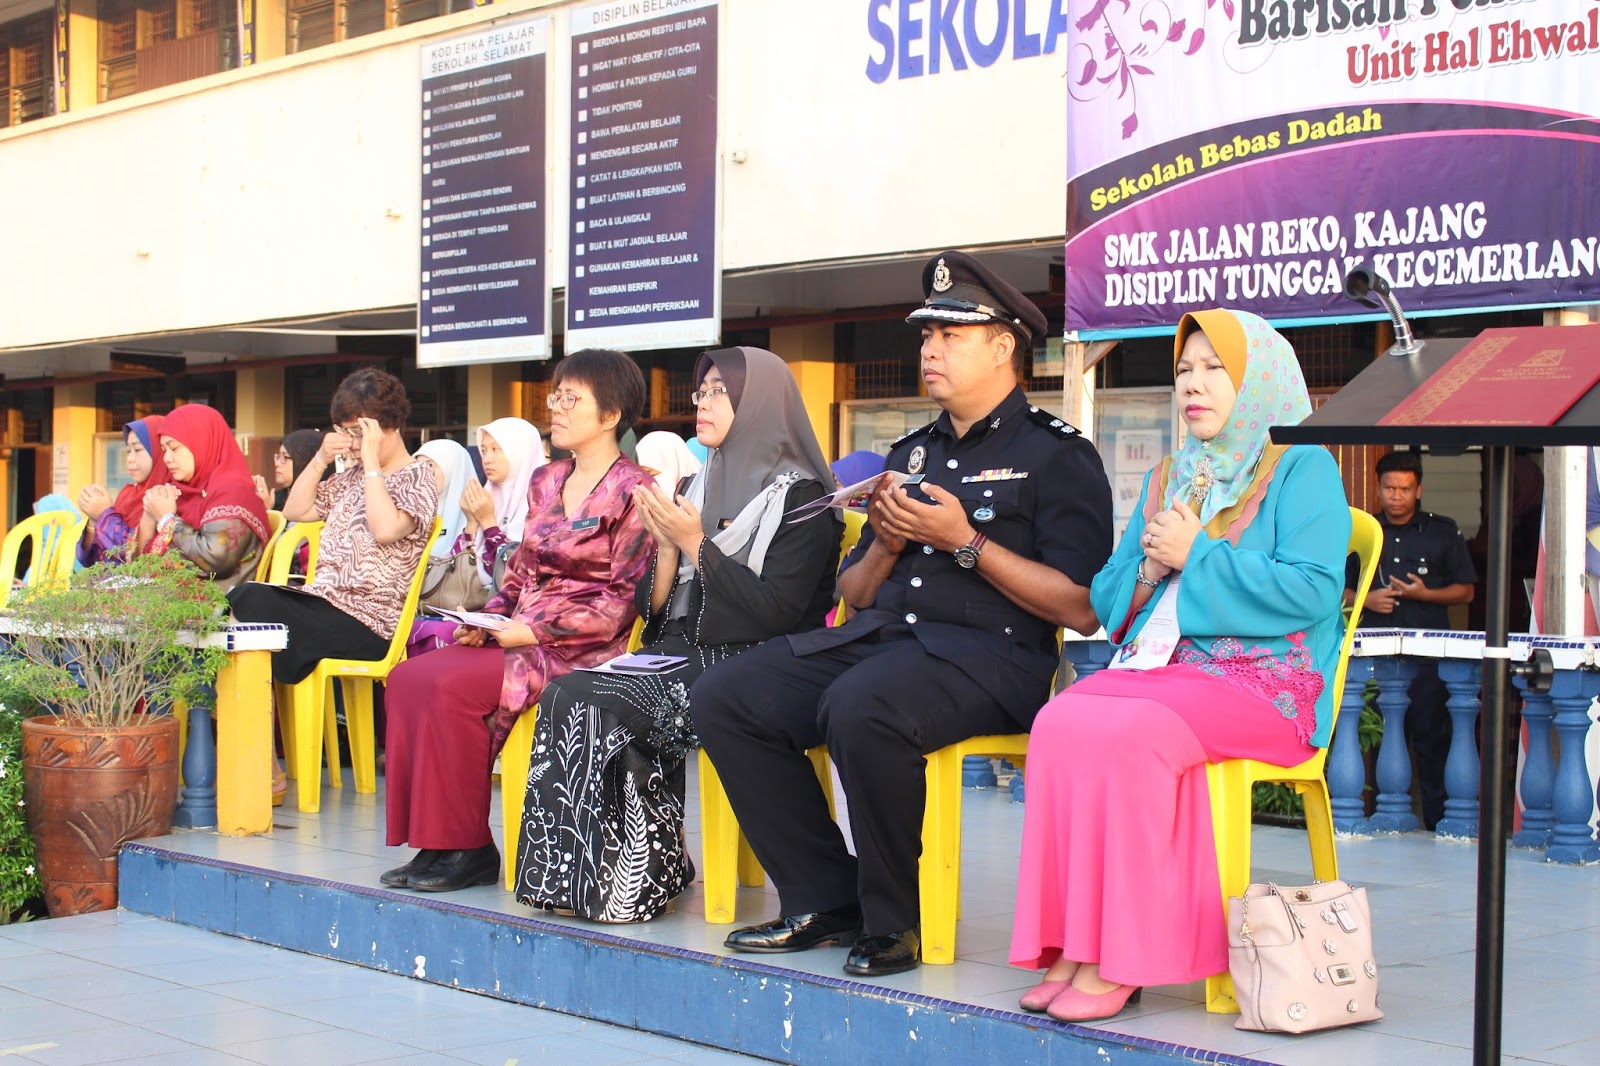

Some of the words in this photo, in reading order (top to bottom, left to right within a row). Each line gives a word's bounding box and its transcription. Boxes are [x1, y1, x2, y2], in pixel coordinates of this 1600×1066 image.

[593, 6, 639, 24] DISIPLIN
[432, 47, 452, 59] KOD
[456, 38, 484, 54] ETIKA
[489, 27, 534, 46] PELAJAR
[593, 36, 619, 48] BERDOA
[620, 35, 625, 43] &
[626, 29, 650, 41] MOHON
[652, 24, 674, 35] RESTU
[675, 22, 686, 30] IBU
[687, 17, 706, 28] BAPA
[1347, 40, 1416, 84] Unit
[1424, 27, 1479, 73] Hal
[1488, 7, 1600, 64] Ehwal
[432, 54, 477, 73] SEKOLAH
[484, 42, 531, 61] SELAMAT
[593, 60, 612, 71] INGAT
[613, 57, 627, 67] NIAT
[632, 49, 663, 63] OBJEKTIF
[592, 80, 619, 93] HORMAT
[620, 79, 624, 88] &
[626, 75, 647, 86] PATUH
[649, 70, 676, 82] KEPADA
[678, 66, 697, 77] GURU
[592, 105, 611, 116] TIDAK
[612, 100, 642, 113] PONTENG
[591, 128, 610, 138] BAWA
[611, 121, 649, 135] PERALATAN
[651, 116, 681, 128] BELAJAR
[591, 146, 630, 160] MENDENGAR
[631, 142, 657, 154] SECARA
[659, 139, 678, 149] AKTIF
[1090, 154, 1195, 211] Sekolah
[1199, 130, 1281, 169] Bebas
[1287, 108, 1382, 145] Dadah
[591, 172, 611, 183] CATAT
[612, 170, 617, 179] &
[618, 165, 662, 179] LENGKAPKAN
[664, 162, 682, 171] NOTA
[590, 194, 608, 204] BUAT
[608, 190, 635, 202] LATIHAN
[636, 189, 641, 198] &
[643, 183, 686, 197] BERBINCANG
[589, 219, 607, 228] BACA
[609, 217, 613, 225] &
[615, 213, 651, 225] ULANGKAJI
[589, 241, 607, 251] BUAT
[608, 240, 612, 248] &
[614, 237, 628, 247] IKUT
[629, 235, 655, 246] JADUAL
[656, 232, 688, 243] BELAJAR
[1104, 231, 1159, 268] SMK
[1164, 222, 1255, 264] JALAN
[1261, 215, 1348, 258] REKO,
[1354, 201, 1487, 249] KAJANG
[589, 262, 621, 273] GUNAKAN
[622, 258, 659, 269] KEMAHIRAN
[661, 254, 691, 265] BELAJAR
[693, 254, 698, 262] &
[1104, 267, 1218, 307] DISIPLIN
[1373, 236, 1600, 289] KECEMERLAN
[589, 284, 626, 296] KEMAHIRAN
[628, 281, 657, 293] BERFIKIR
[589, 308, 608, 317] SEDIA
[609, 304, 651, 316] MENGHADAPI
[653, 300, 699, 312] PEPERIKSAAN
